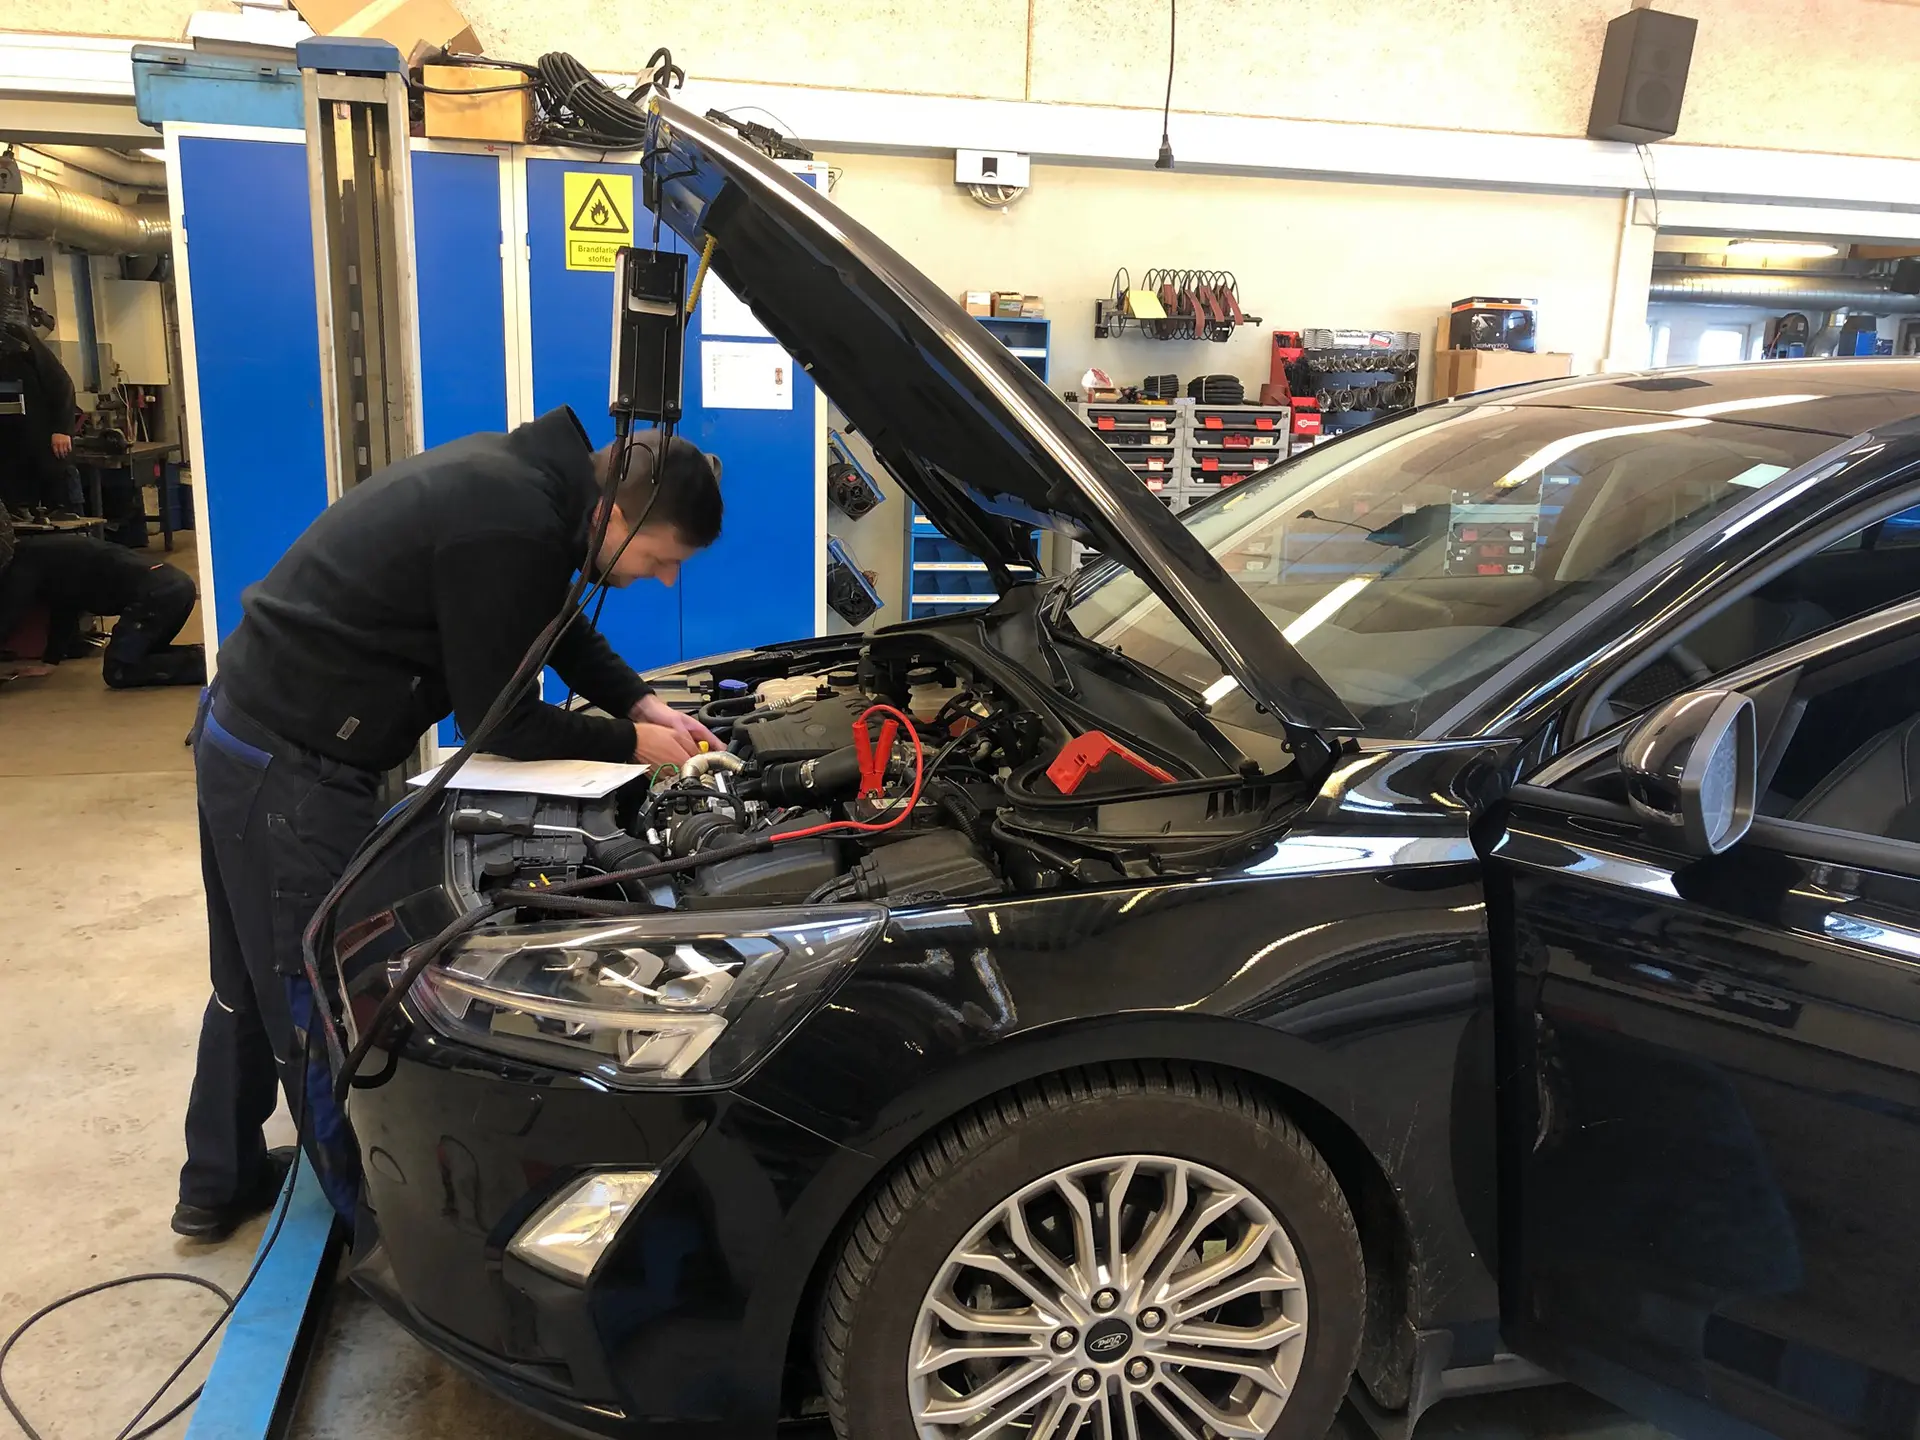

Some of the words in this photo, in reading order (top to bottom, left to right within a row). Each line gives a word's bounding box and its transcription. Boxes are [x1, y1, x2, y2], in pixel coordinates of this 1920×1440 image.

[577, 245, 618, 255] Brandfarlig
[588, 255, 612, 263] stoffer
[1098, 1335, 1122, 1349] Ford
